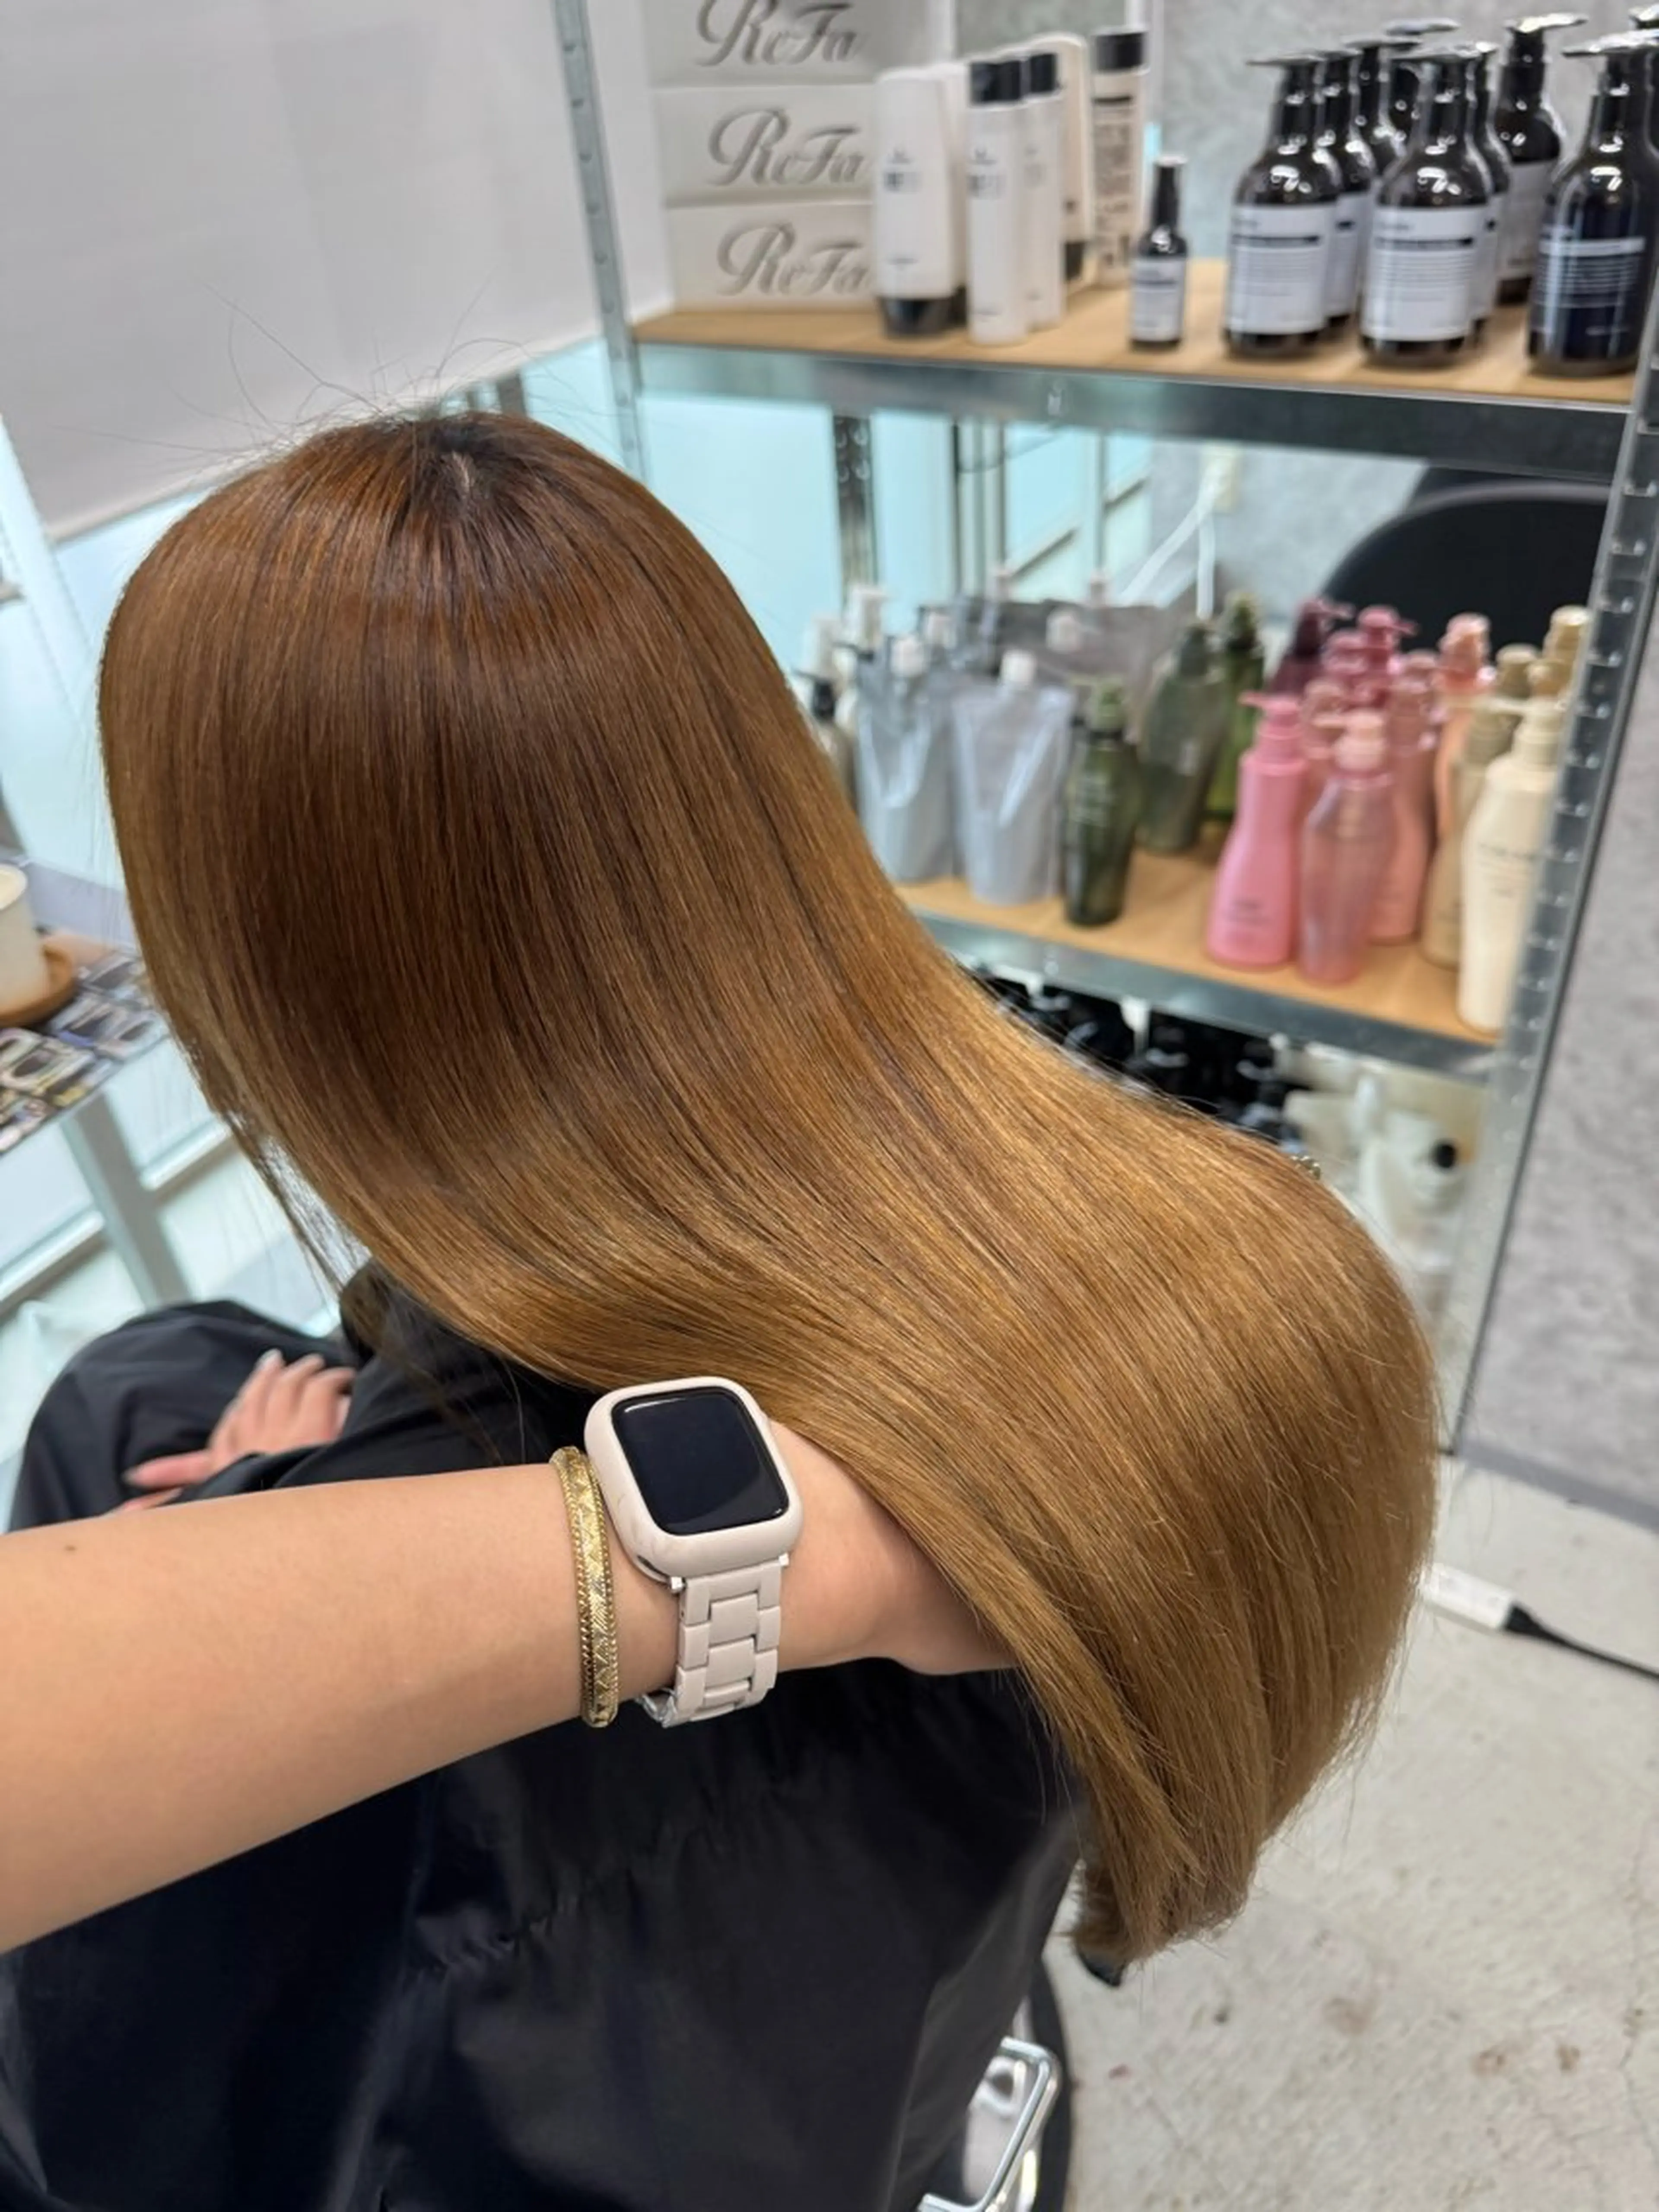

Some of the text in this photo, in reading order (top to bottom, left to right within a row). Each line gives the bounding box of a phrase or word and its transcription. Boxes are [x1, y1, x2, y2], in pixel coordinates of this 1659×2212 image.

[693, 0, 863, 67] ReFa
[706, 105, 867, 186] ReFa
[717, 220, 871, 296] ReFa
